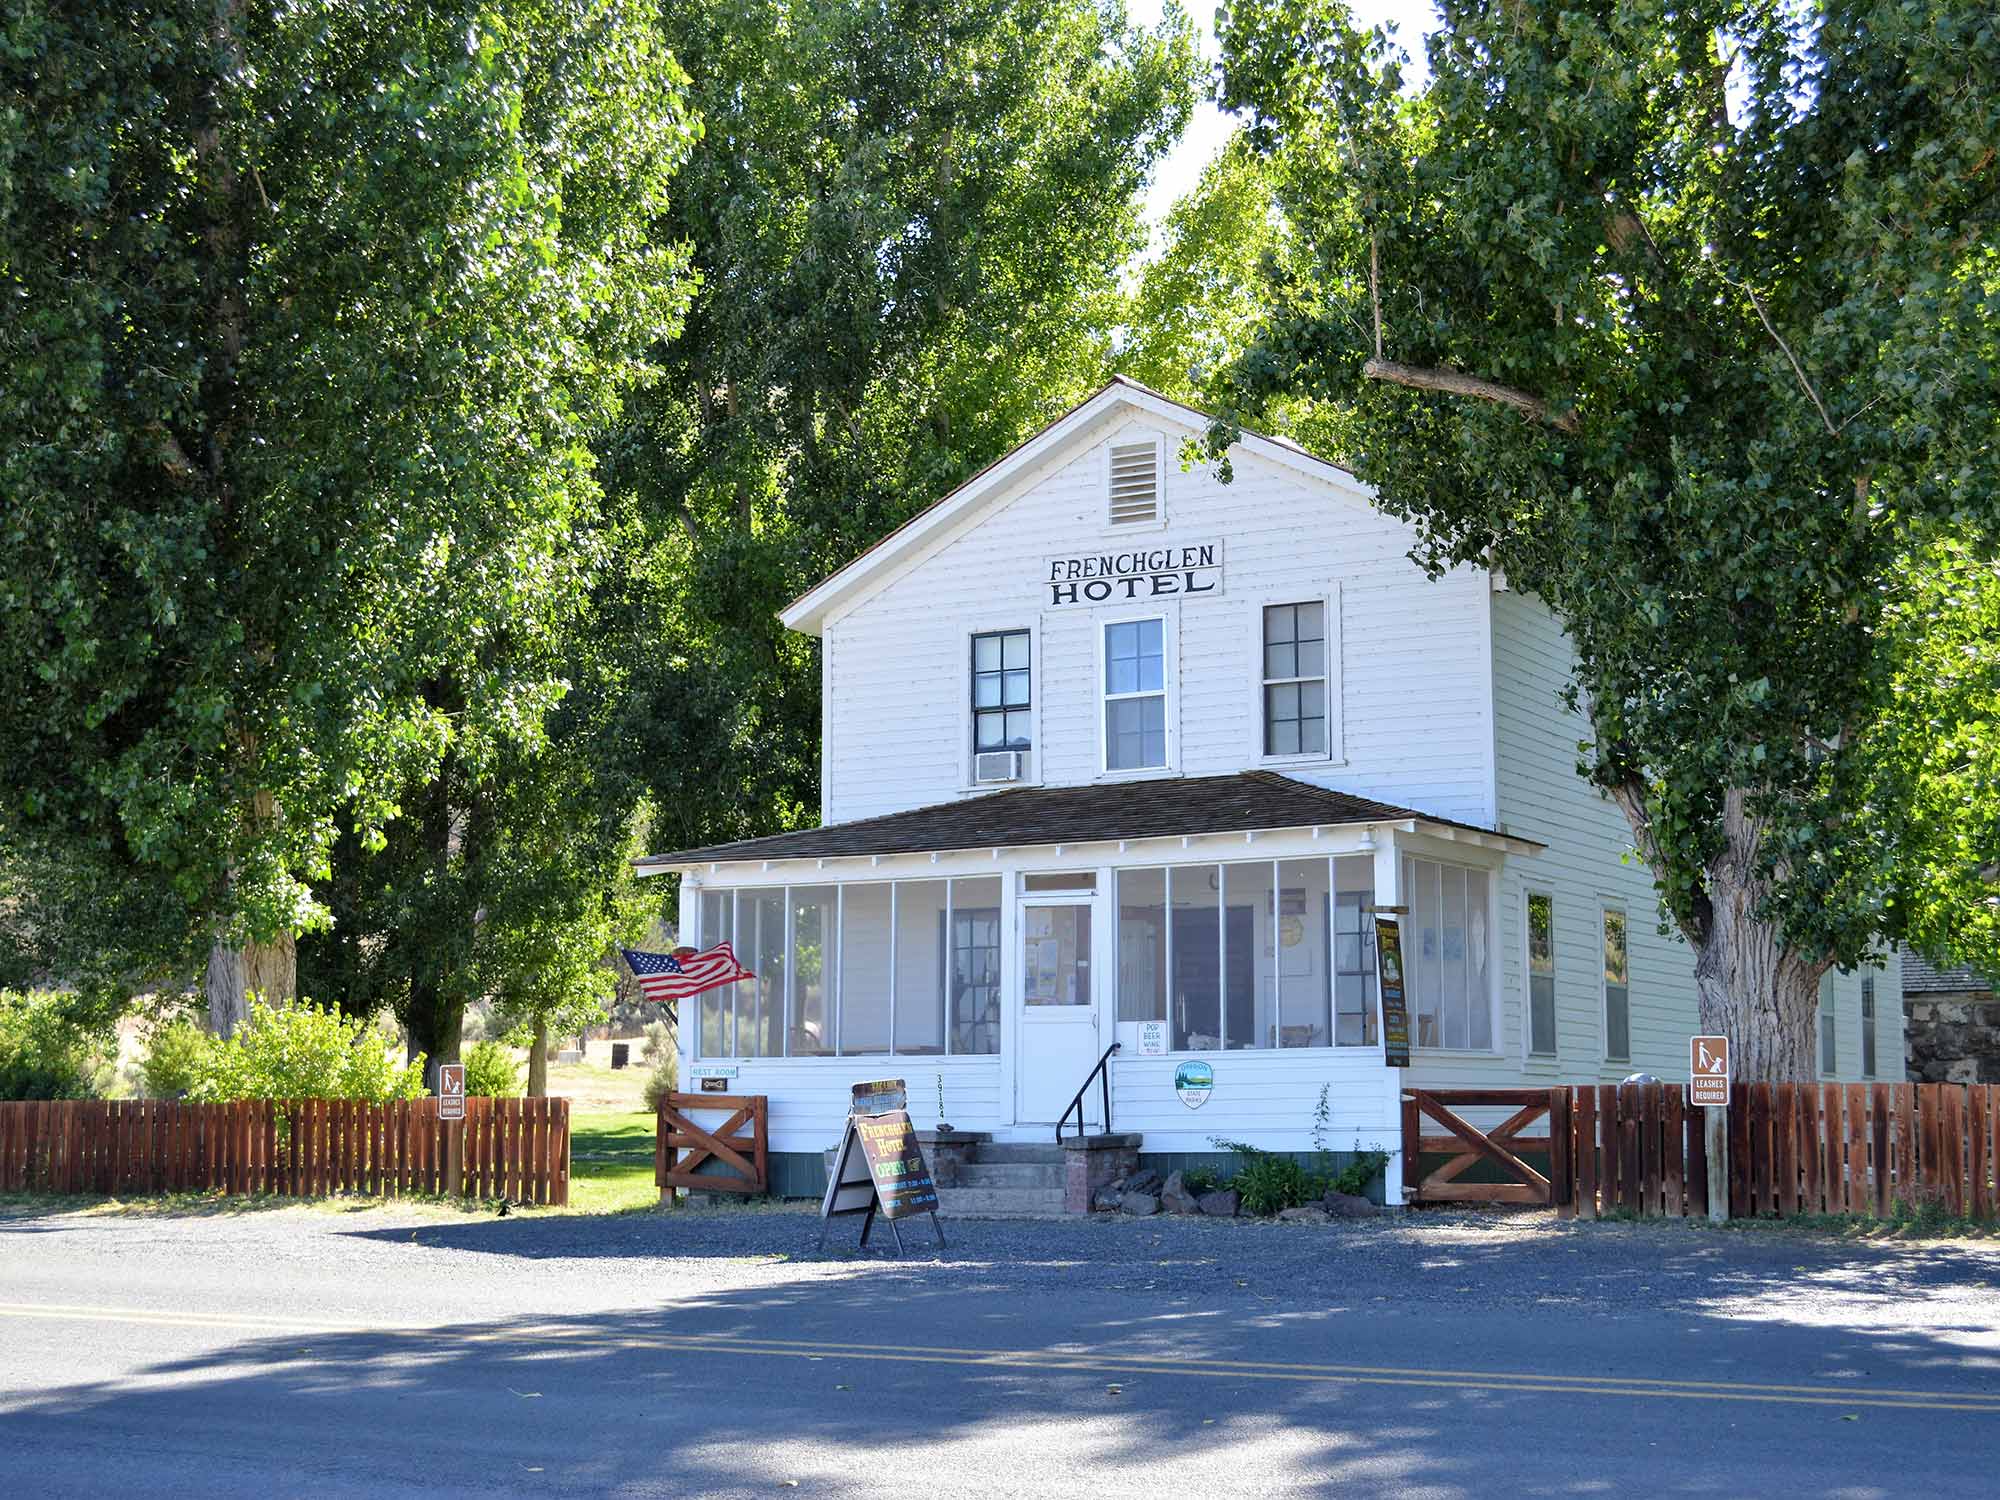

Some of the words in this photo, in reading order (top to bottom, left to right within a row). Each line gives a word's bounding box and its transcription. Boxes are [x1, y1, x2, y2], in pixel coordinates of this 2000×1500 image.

[1050, 545, 1214, 581] FRENCHGLEN
[1051, 571, 1216, 606] HOTEL
[1146, 1023, 1159, 1032] POP
[1143, 1032, 1160, 1040] BEER
[692, 1068, 712, 1077] REST
[715, 1068, 736, 1076] ROOM
[1696, 1080, 1724, 1088] LEASHES
[1695, 1091, 1725, 1100] REQUIRED
